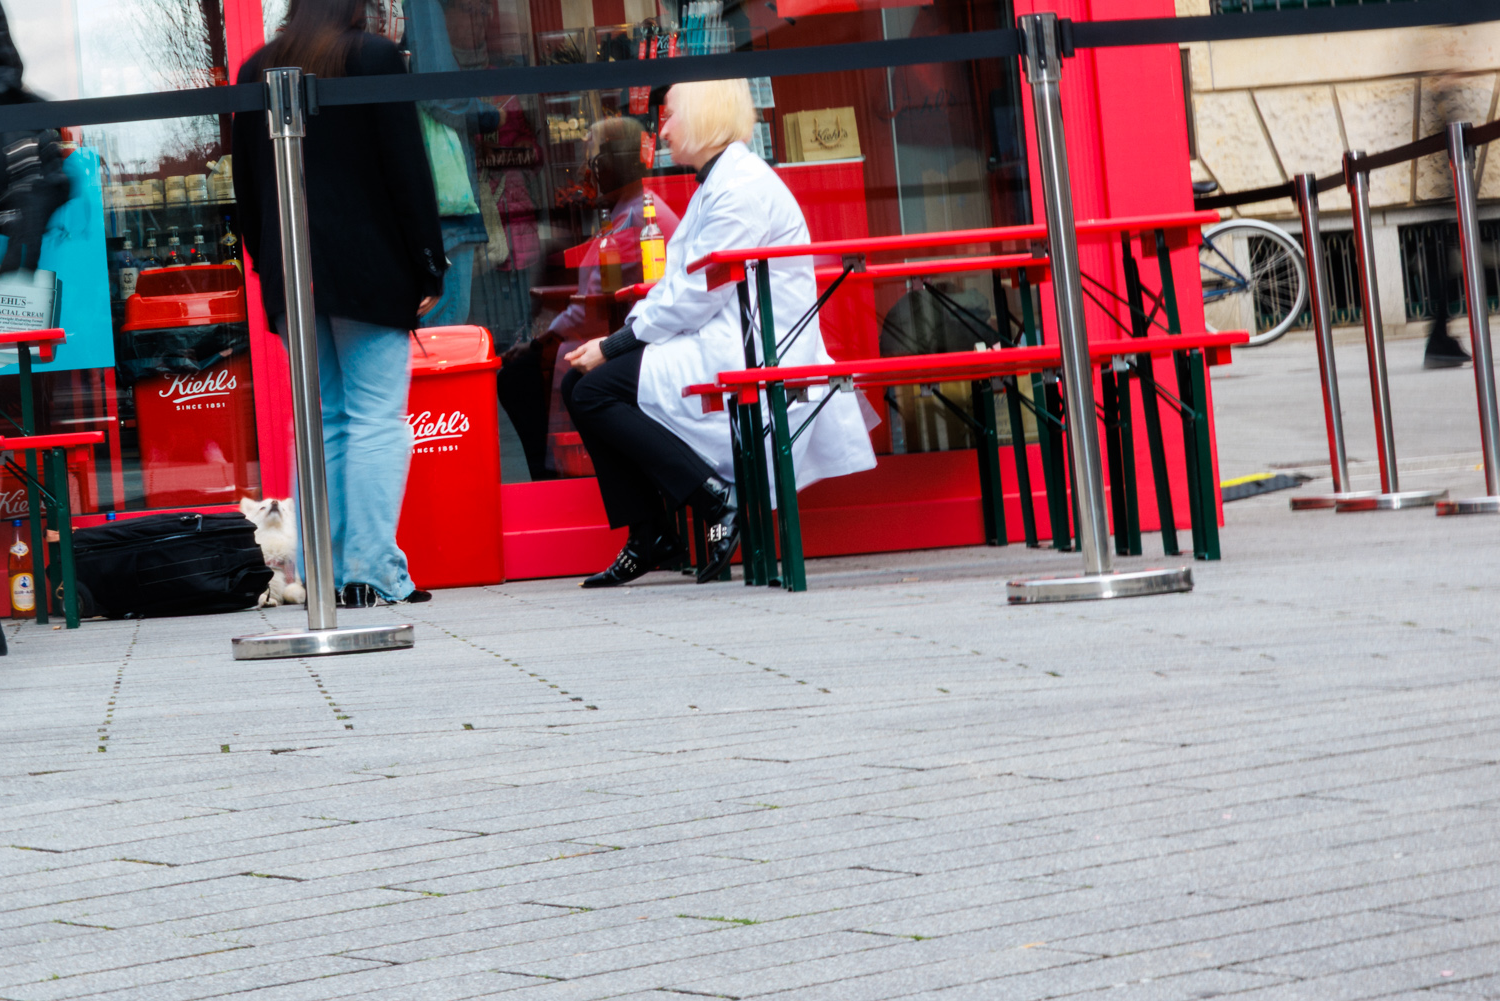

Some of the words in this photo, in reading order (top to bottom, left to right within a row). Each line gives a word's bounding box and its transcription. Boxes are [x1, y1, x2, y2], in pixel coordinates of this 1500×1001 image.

[176, 403, 202, 411] SINCE
[398, 411, 470, 438] Kiehl's
[438, 444, 458, 453] 1851
